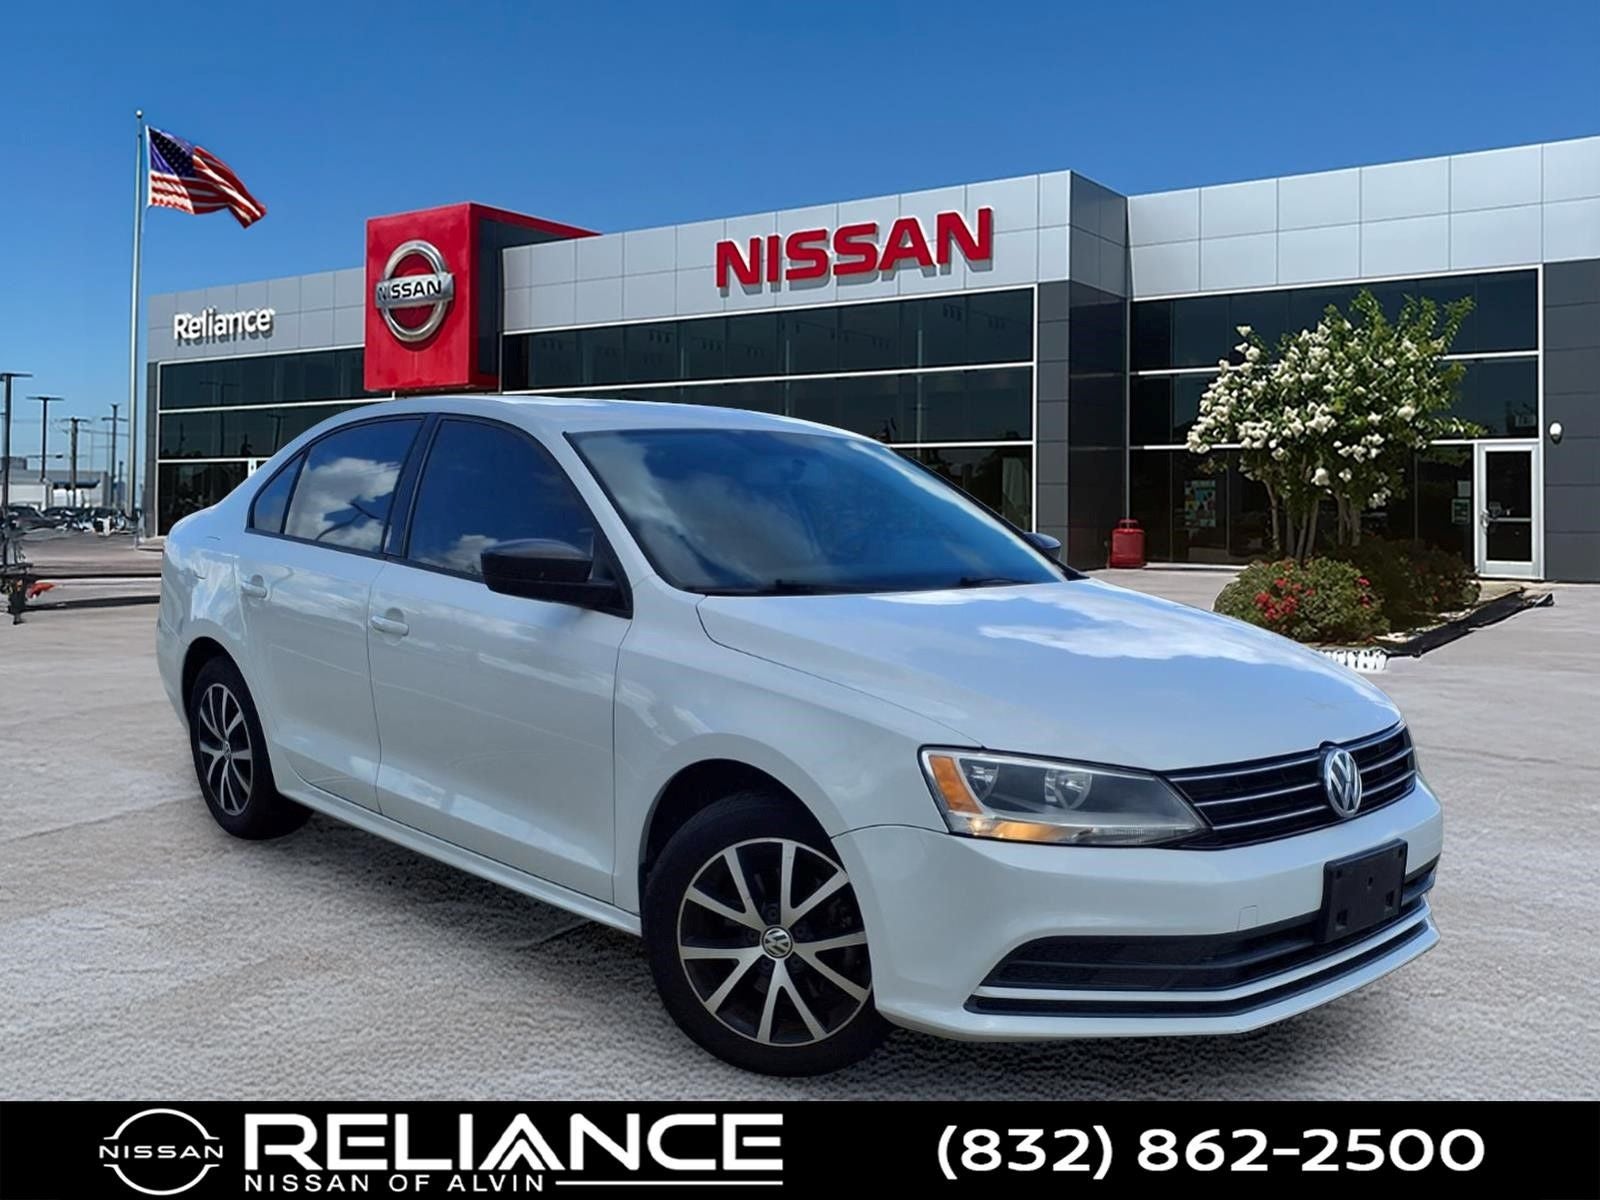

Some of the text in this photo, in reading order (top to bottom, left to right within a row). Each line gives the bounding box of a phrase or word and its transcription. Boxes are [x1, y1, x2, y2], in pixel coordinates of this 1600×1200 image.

[715, 207, 992, 288] NISSAN
[378, 279, 442, 301] NISSAN
[173, 306, 274, 340] Reliance
